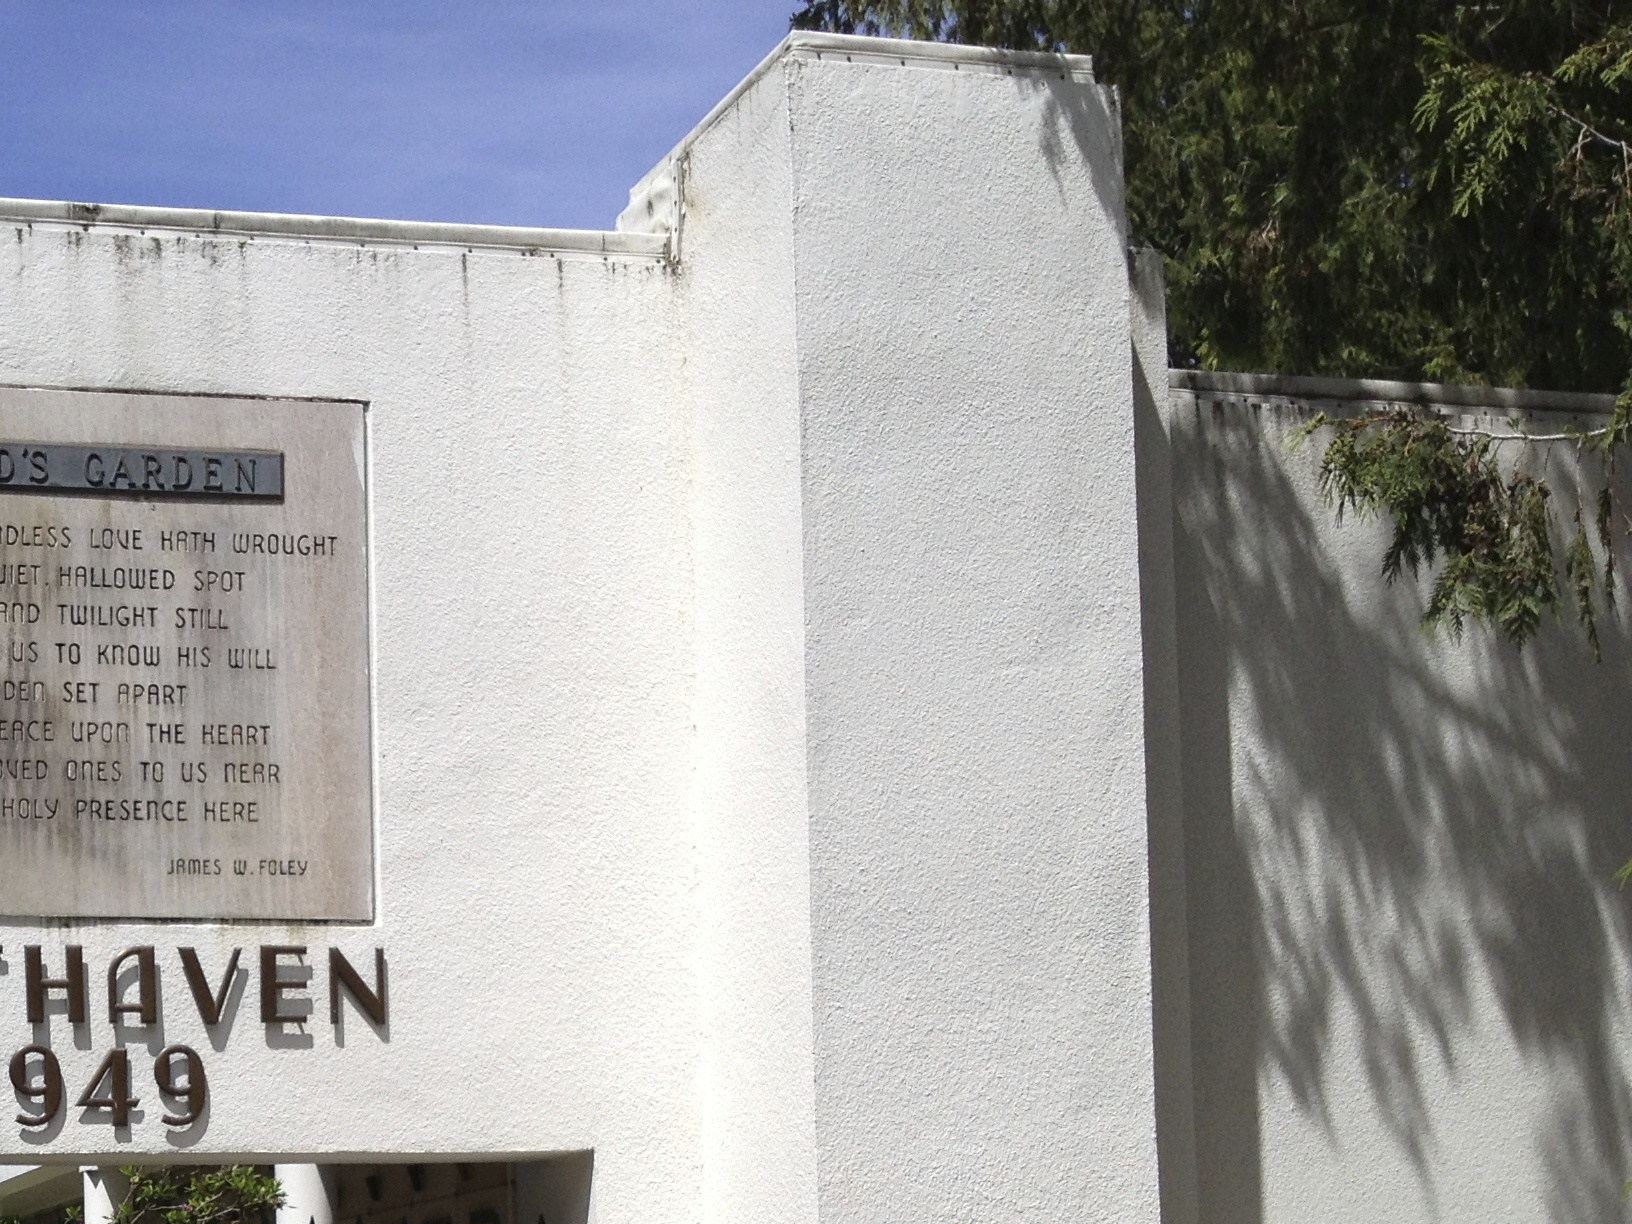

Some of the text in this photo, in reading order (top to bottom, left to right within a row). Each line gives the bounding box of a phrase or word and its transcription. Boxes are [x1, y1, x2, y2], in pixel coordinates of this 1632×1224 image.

[84, 453, 256, 492] GARDEN
[90, 528, 142, 550] LOVE
[161, 530, 215, 552] HATH
[232, 533, 338, 556] WROUGHT
[59, 566, 175, 589] HALLOWED
[194, 570, 245, 592] SPOT
[57, 604, 158, 627] TWILIGHT
[175, 607, 228, 630] STILL
[11, 641, 38, 663] US
[55, 643, 80, 665] TO
[97, 644, 160, 666] KNOW
[177, 646, 211, 668] HIS
[228, 648, 277, 670] WILL
[62, 681, 99, 703] SET
[118, 683, 187, 705] APART
[71, 722, 129, 743] UPON
[146, 723, 185, 744] THE
[202, 725, 270, 746] HEART
[66, 760, 121, 782] ONES
[140, 762, 164, 783] TO
[181, 762, 207, 783] US
[224, 763, 280, 784] NEAR
[2, 798, 58, 819] HOLY
[76, 799, 188, 822] PRESENCE
[204, 801, 259, 822] HERE
[167, 858, 221, 876] JAMES
[259, 859, 308, 876] FOLEY
